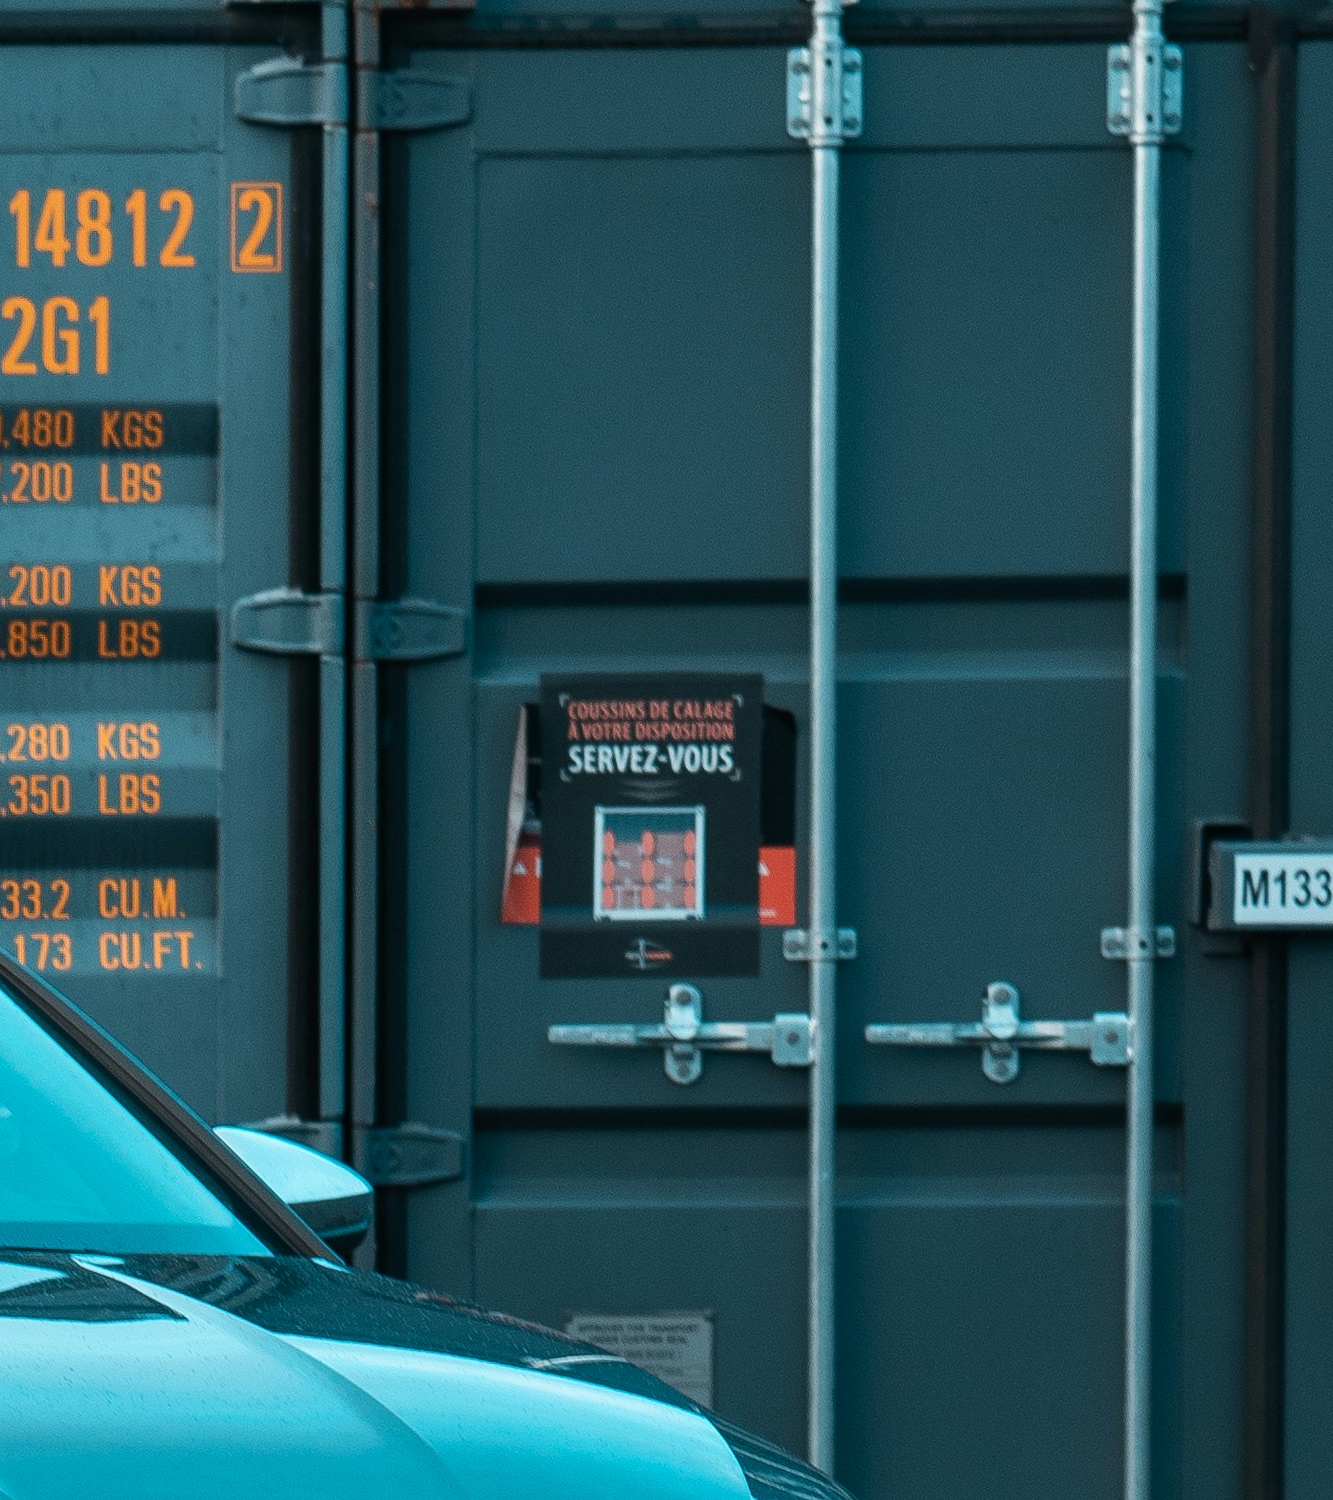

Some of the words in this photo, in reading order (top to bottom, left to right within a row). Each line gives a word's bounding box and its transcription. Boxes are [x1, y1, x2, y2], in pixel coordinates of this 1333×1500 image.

[238, 190, 275, 266] 2
[102, 411, 163, 448] KGS
[100, 462, 162, 503] LBS
[100, 566, 161, 606] KGS
[98, 620, 161, 658] LBS
[568, 700, 645, 720] COUSSINS
[649, 700, 668, 720] DE
[673, 700, 732, 720] CALAGE
[98, 723, 160, 759] KGS
[581, 720, 630, 739] VOTRE
[635, 720, 734, 739] DISPOSITION
[569, 746, 732, 773] SERVEZ-VOUS
[99, 773, 161, 815] LBS
[1, 879, 70, 919] 33.2
[99, 878, 186, 918] CU.M.
[1242, 870, 1333, 907] M133
[99, 931, 203, 969] CU.FT.
